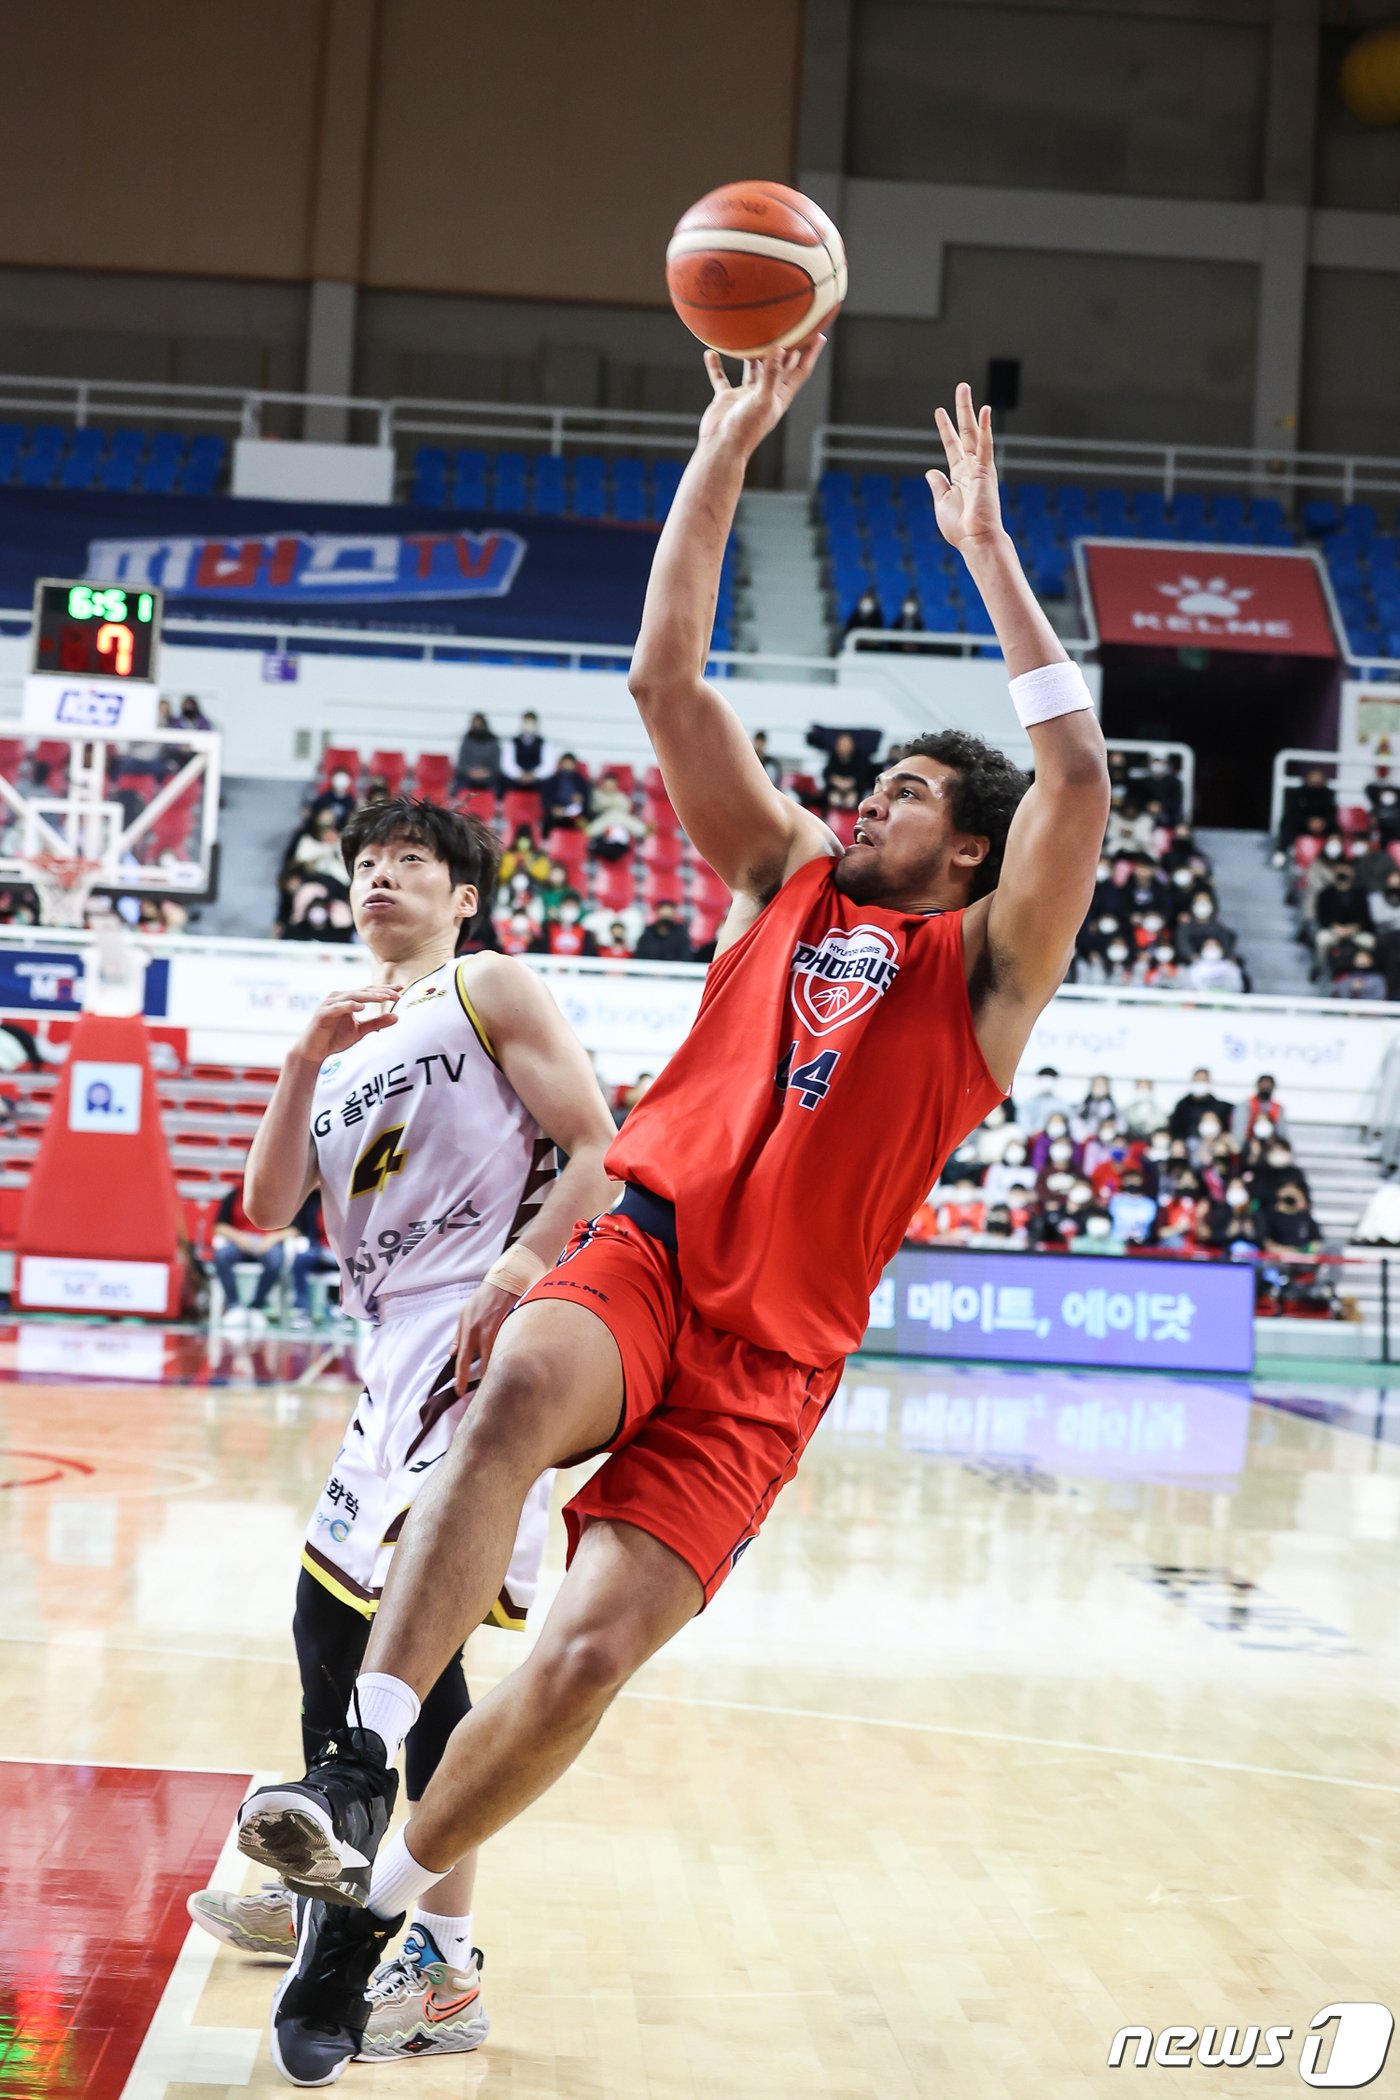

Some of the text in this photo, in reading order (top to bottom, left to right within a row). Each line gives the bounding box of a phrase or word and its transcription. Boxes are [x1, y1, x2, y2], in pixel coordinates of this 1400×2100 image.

[68, 585, 153, 622] 6:51
[1131, 611, 1294, 638] KELME
[96, 622, 134, 676] 7
[791, 945, 899, 993] PHOEBUS
[340, 1063, 415, 1127] 올레드
[415, 1053, 467, 1086] TV
[774, 1040, 841, 1111] 44
[350, 1121, 410, 1200] 4
[542, 1280, 610, 1304] KELME
[907, 1279, 1051, 1340] 메이트,
[1060, 1287, 1197, 1344] 에이닷
[326, 1477, 360, 1521] 화학
